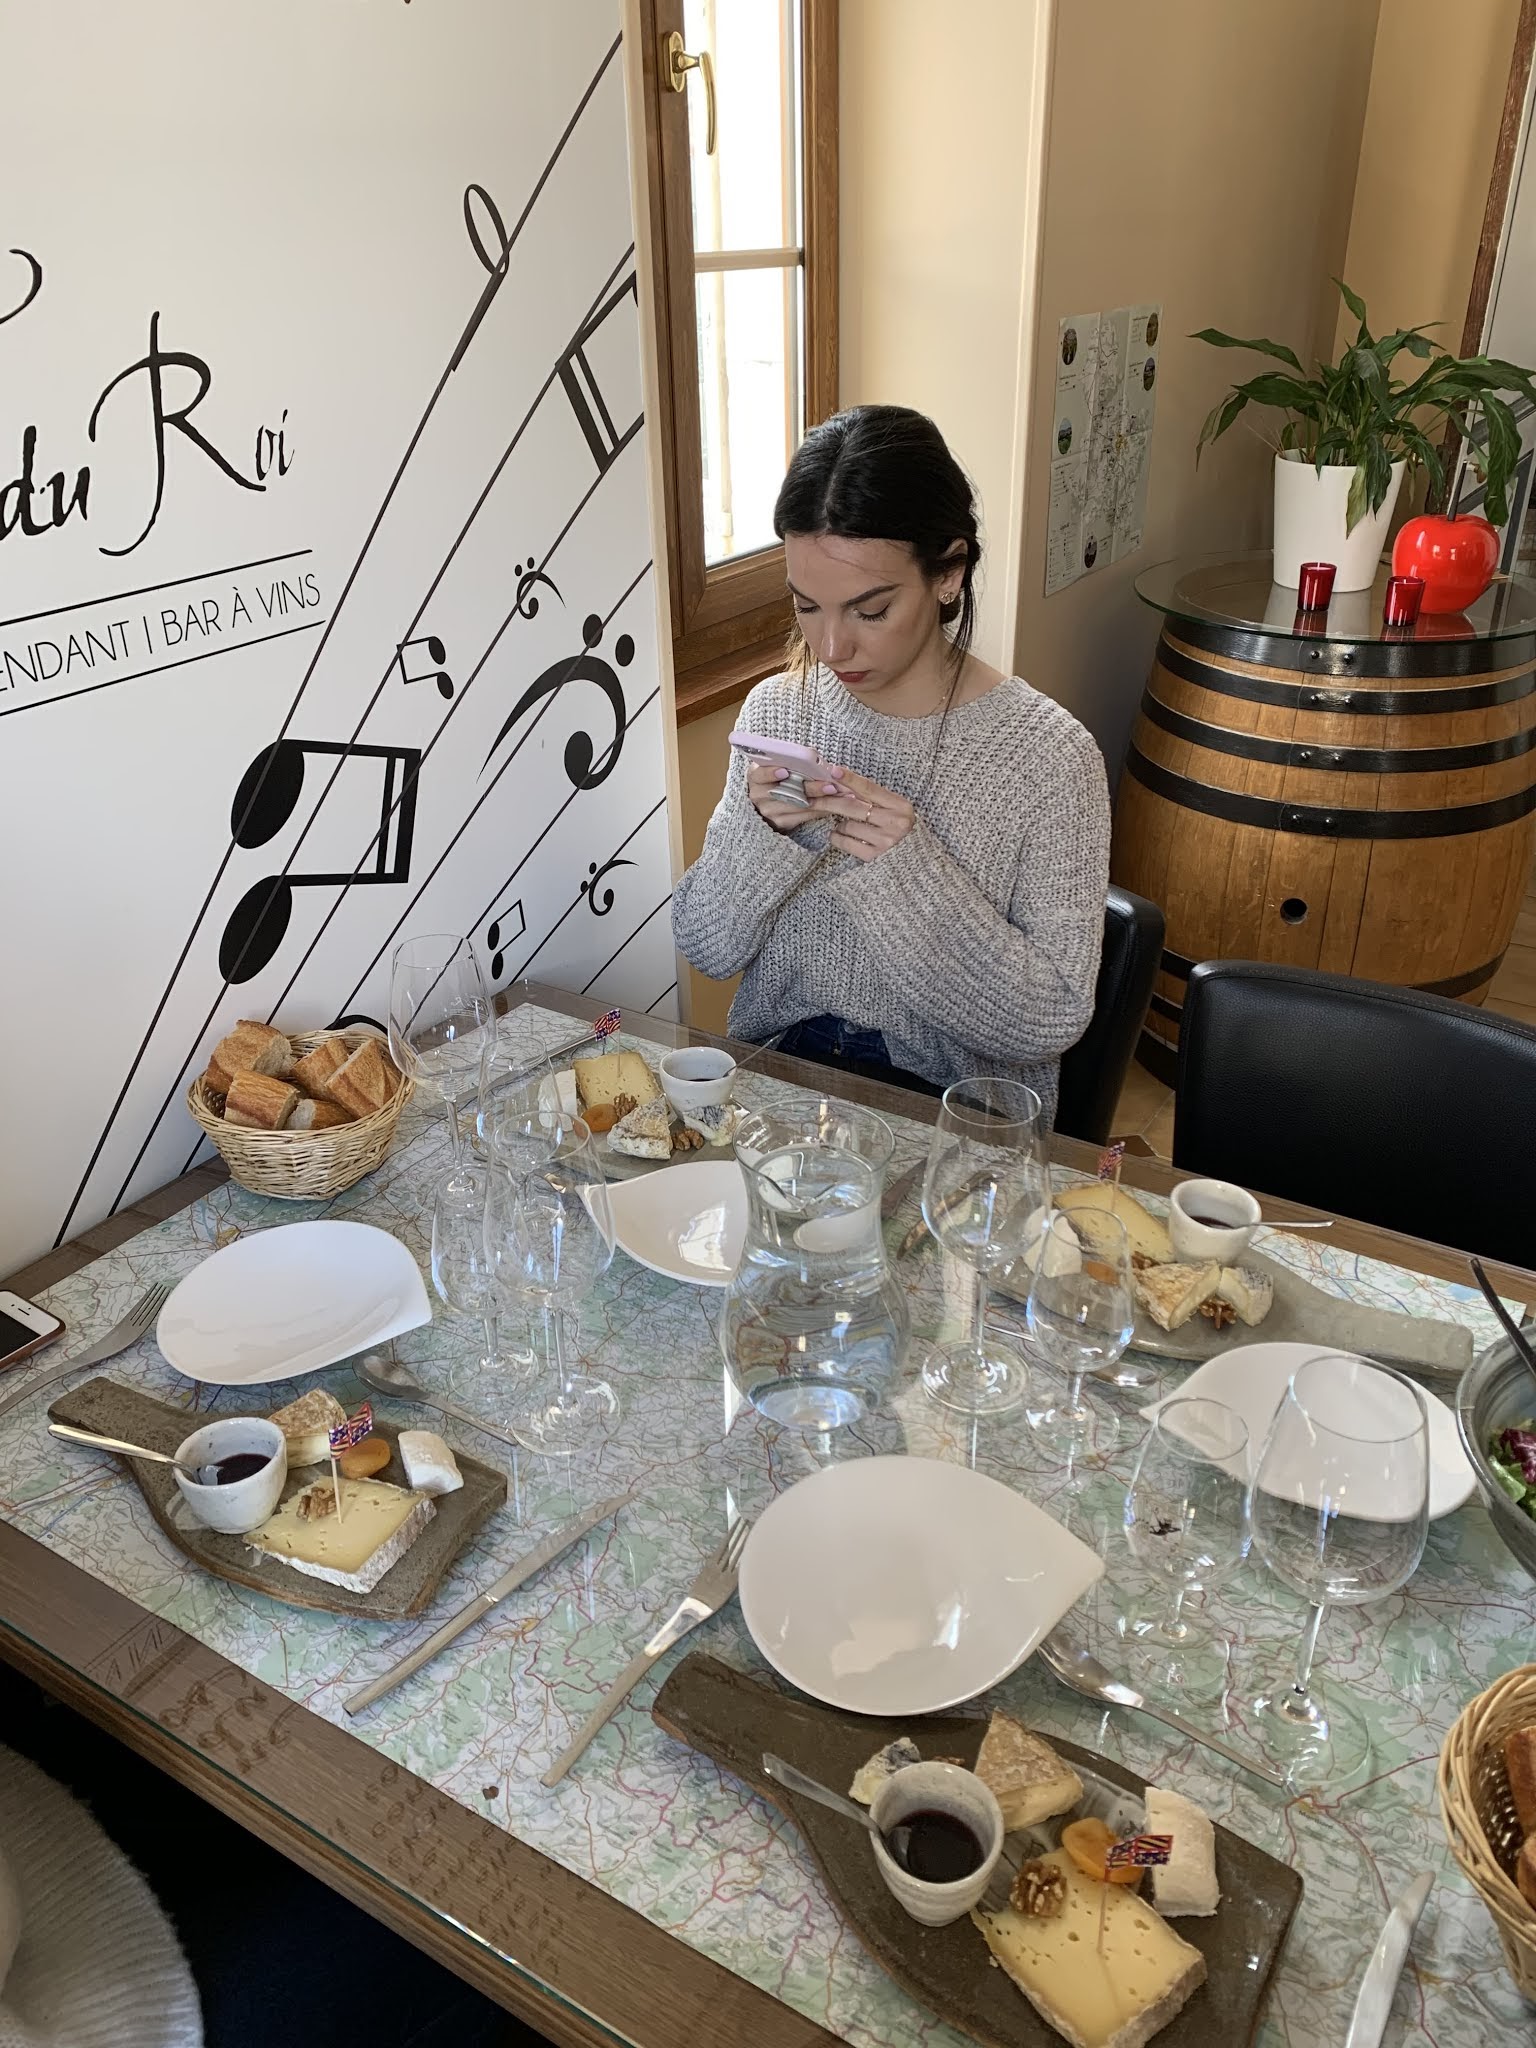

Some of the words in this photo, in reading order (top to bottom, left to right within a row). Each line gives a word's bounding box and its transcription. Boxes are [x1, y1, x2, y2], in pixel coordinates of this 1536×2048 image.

[88, 311, 295, 557] Roi
[161, 599, 222, 646] BAR
[232, 586, 253, 629] À
[256, 573, 321, 618] VINS
